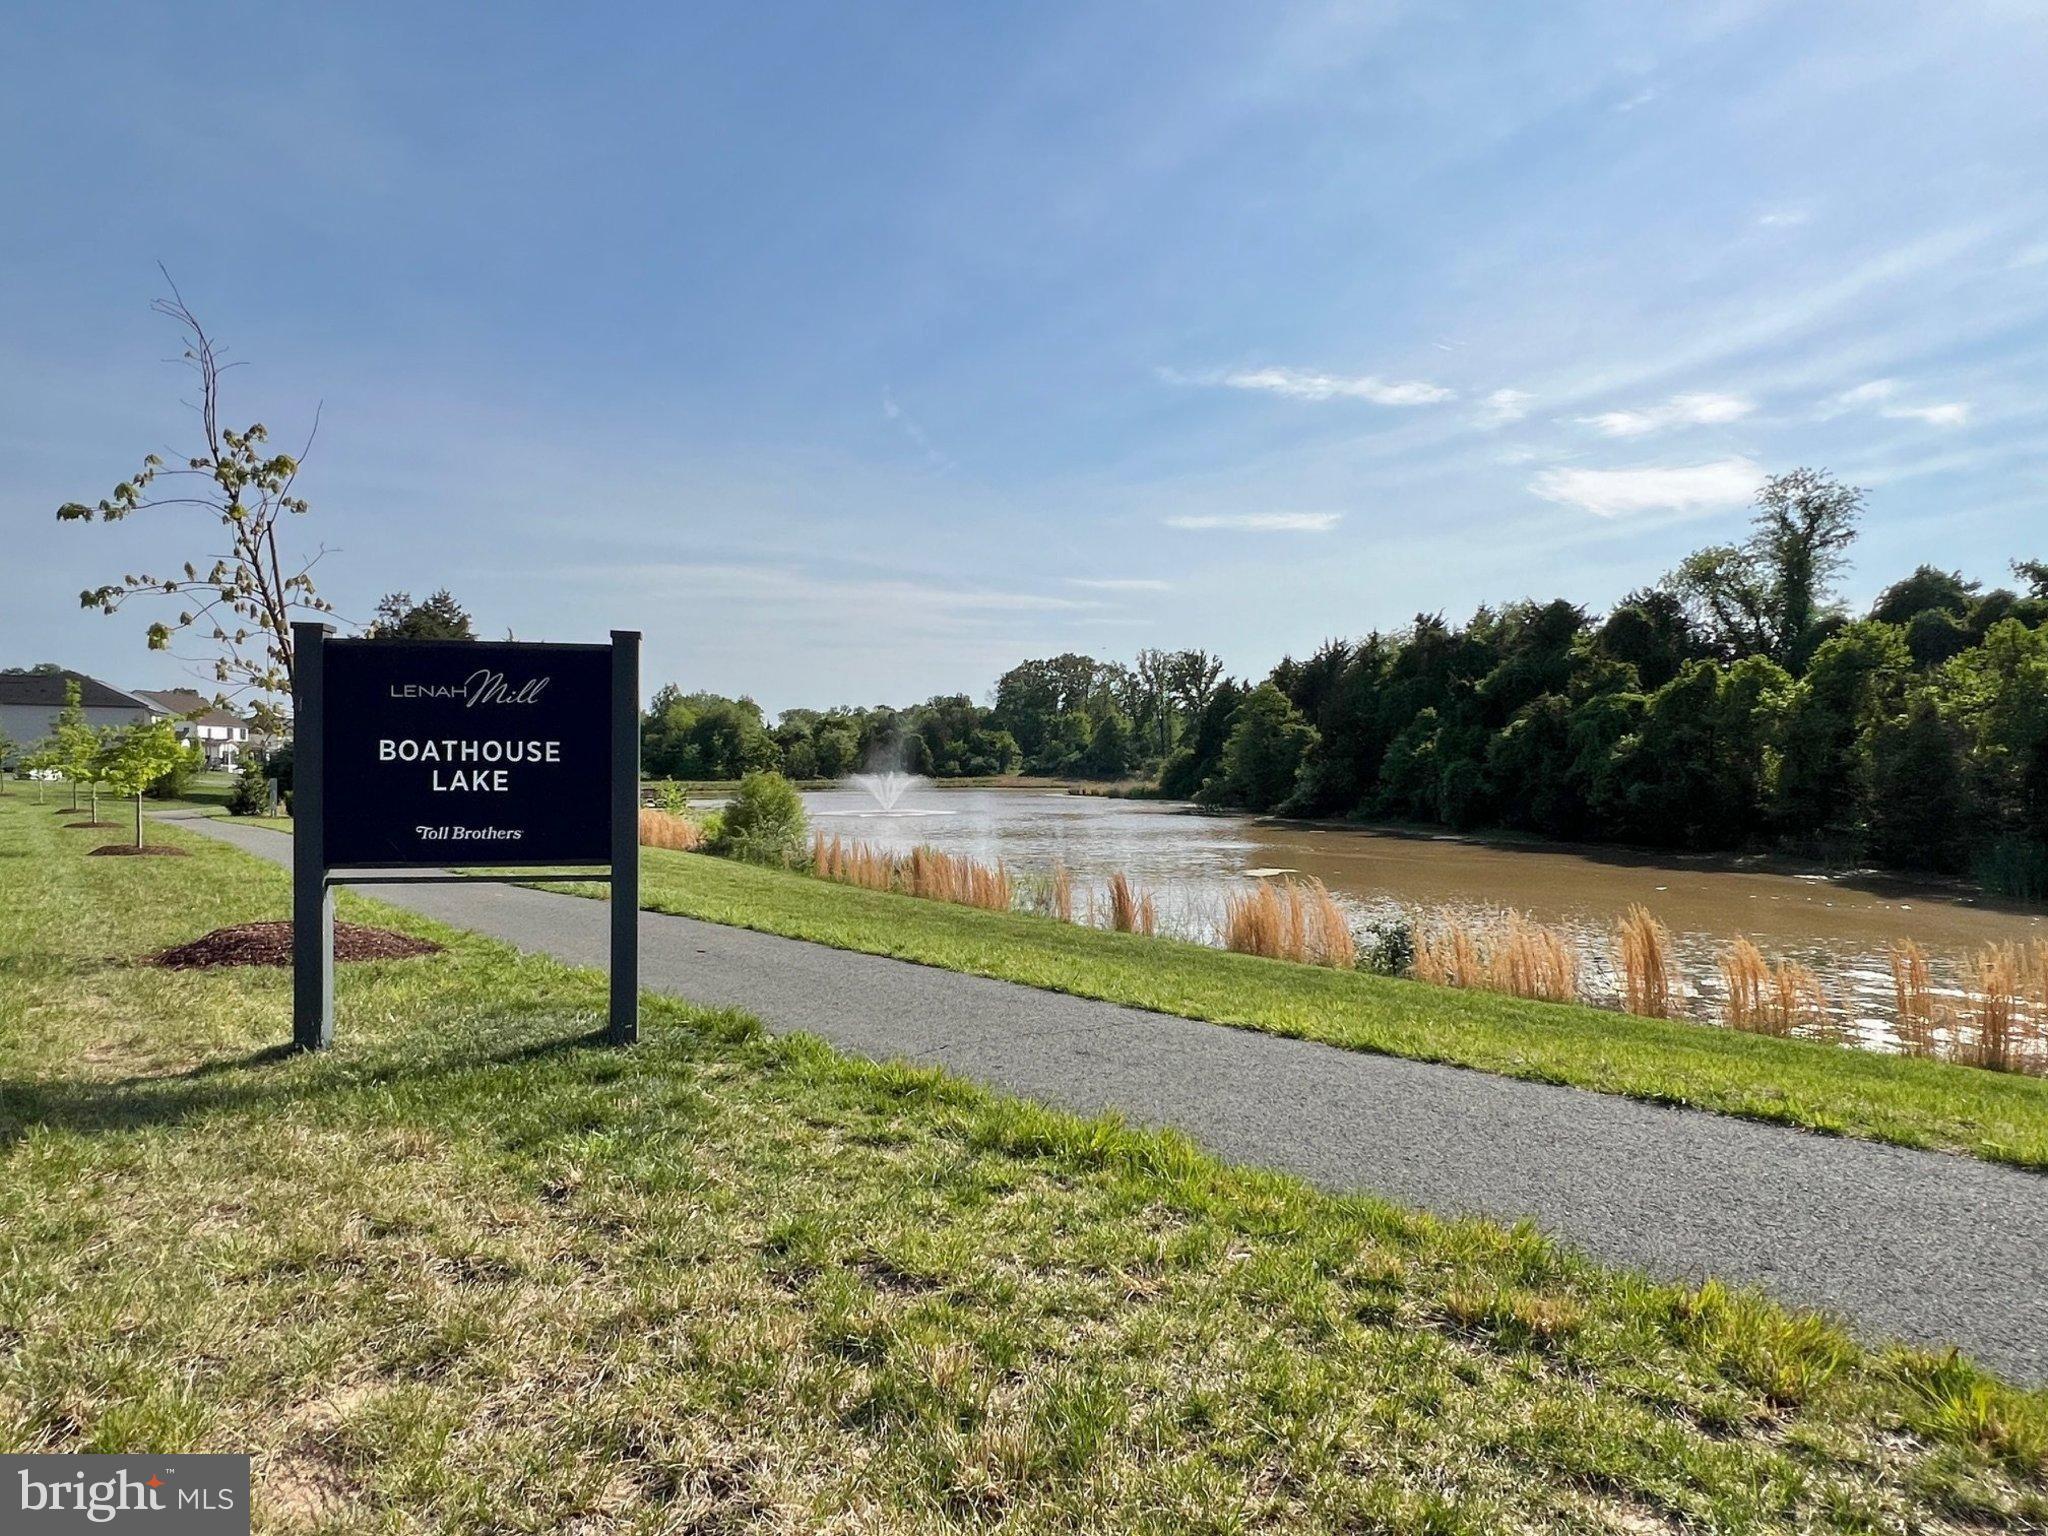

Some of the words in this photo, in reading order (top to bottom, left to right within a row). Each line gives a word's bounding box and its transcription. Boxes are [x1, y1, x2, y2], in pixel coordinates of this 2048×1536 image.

[391, 684, 467, 698] LENAH
[464, 669, 550, 708] Mill
[379, 739, 561, 763] BOATHOUSE
[432, 769, 509, 792] LAKE
[415, 825, 450, 841] Toll
[450, 826, 523, 841] Brothers
